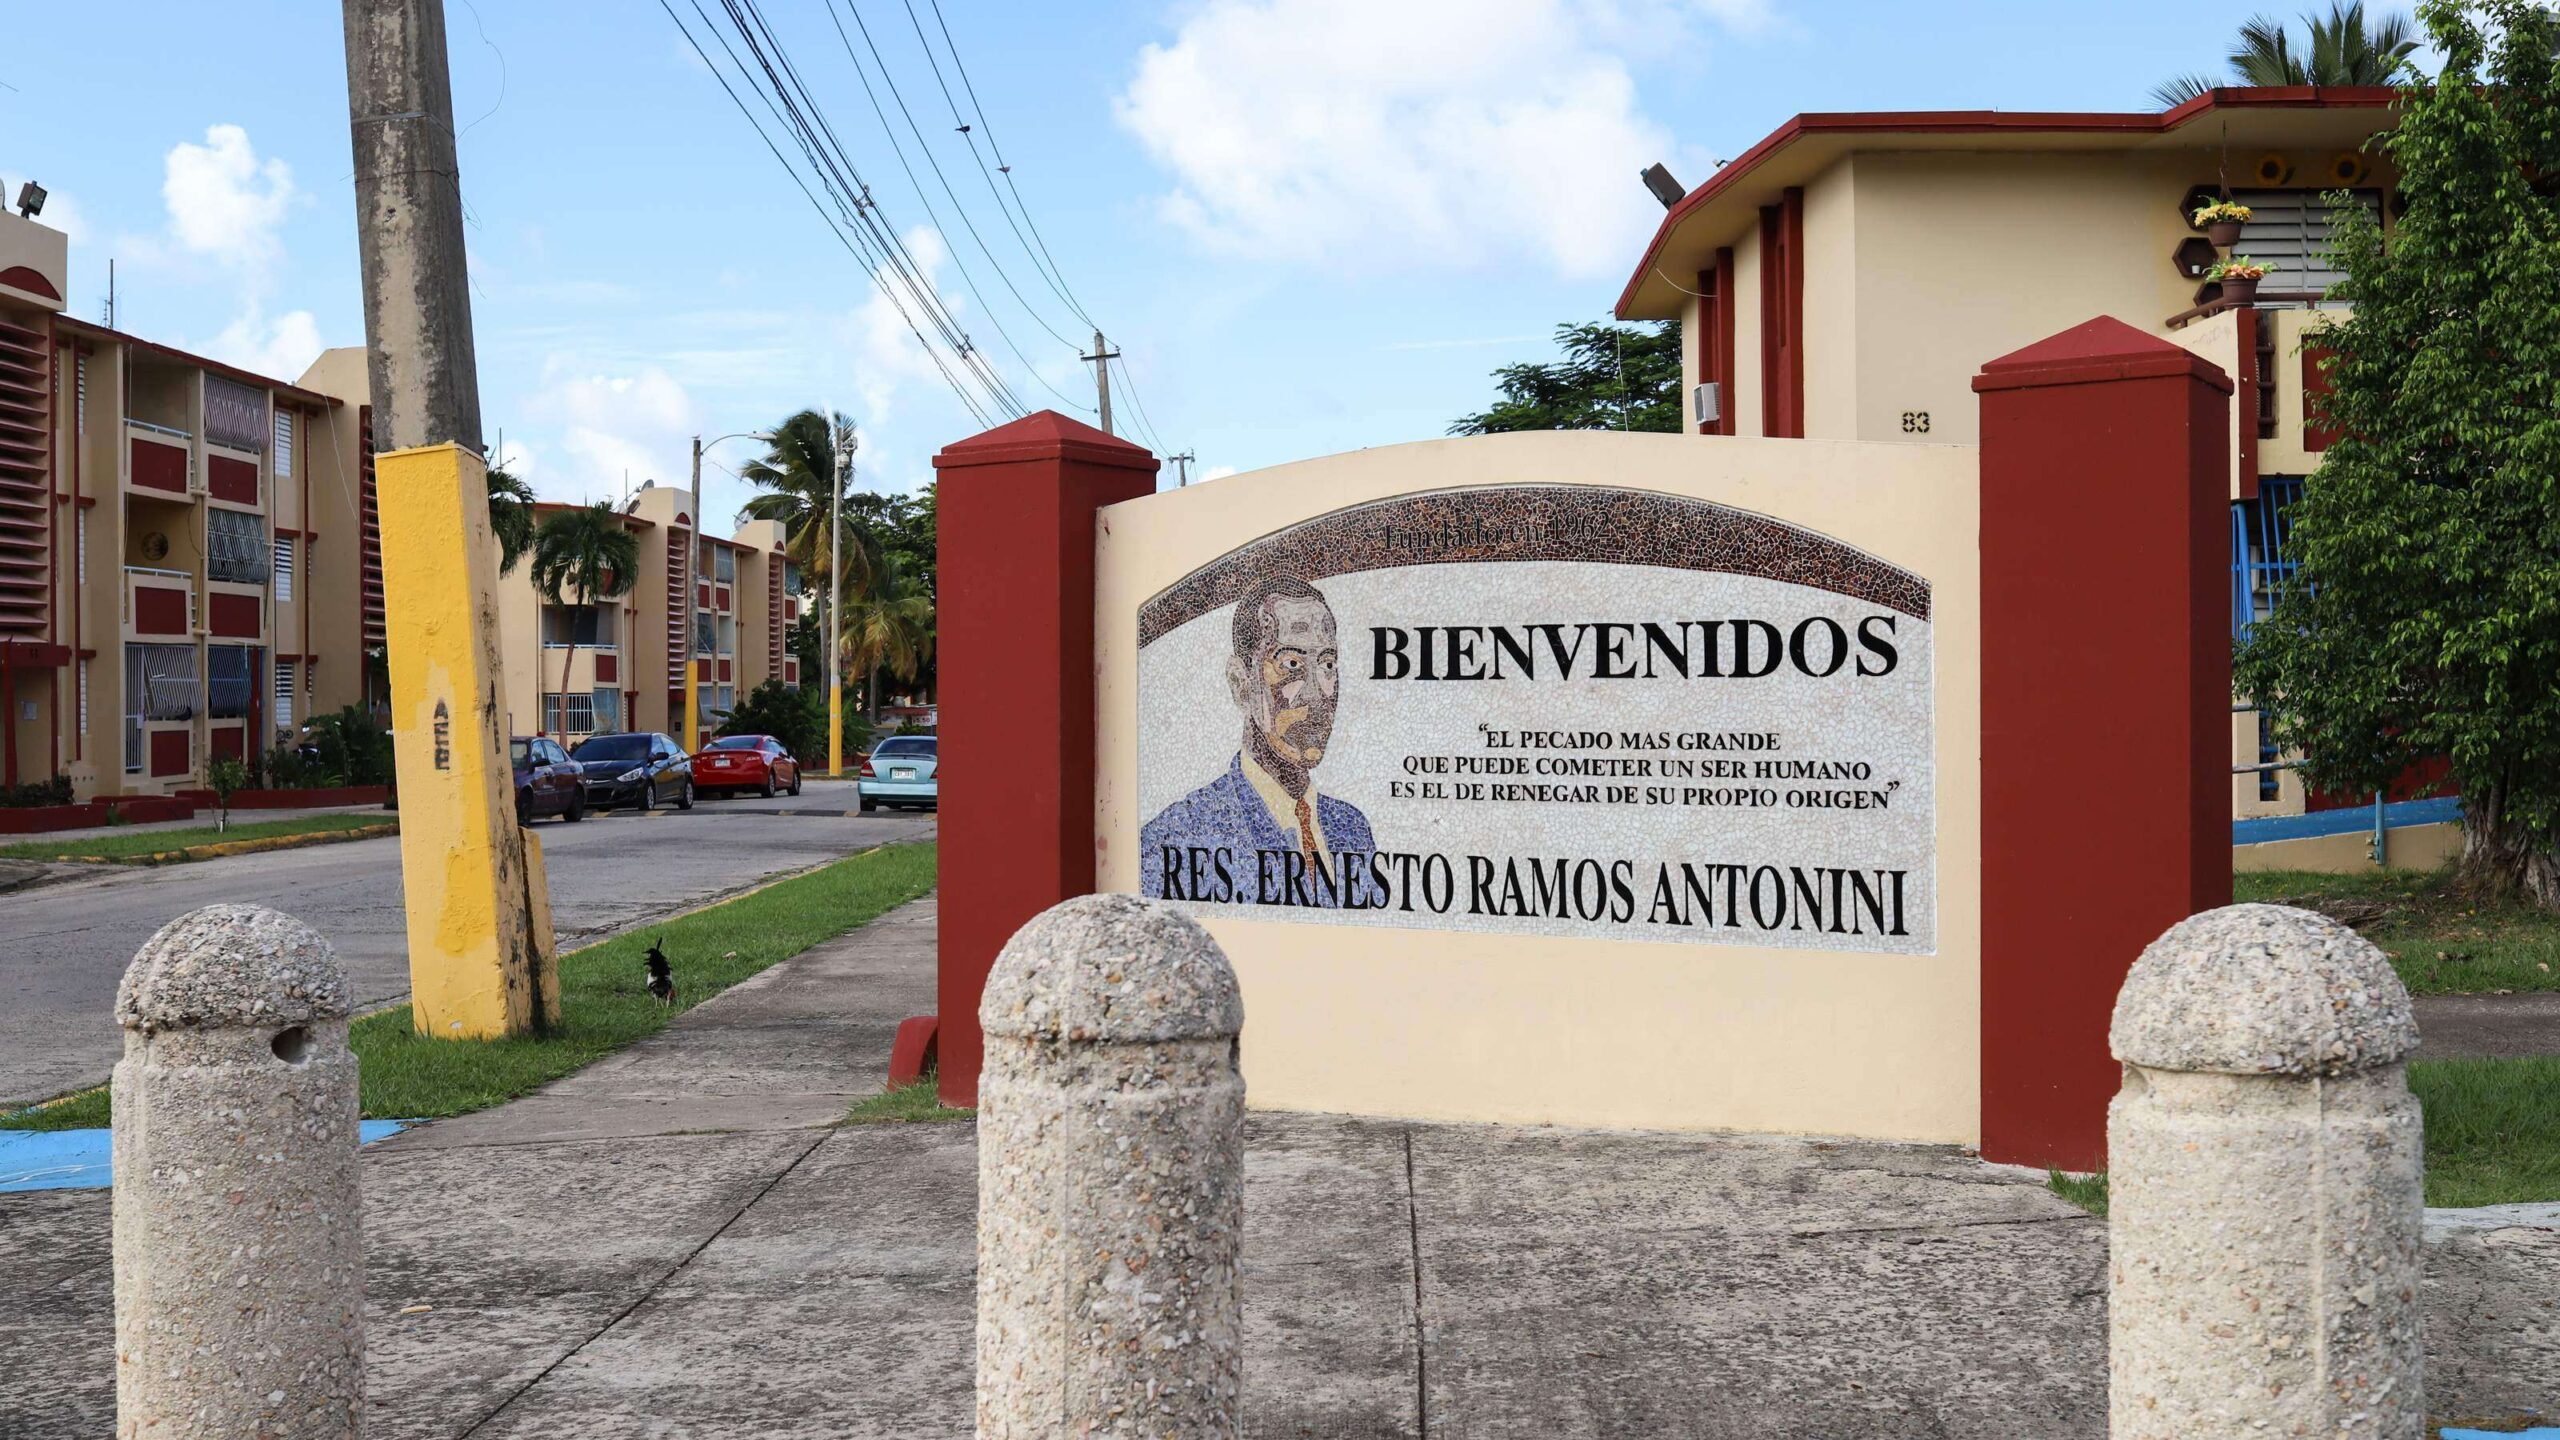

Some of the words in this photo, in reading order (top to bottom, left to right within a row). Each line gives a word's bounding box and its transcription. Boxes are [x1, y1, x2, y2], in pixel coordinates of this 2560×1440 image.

[1902, 411, 1930, 433] 83
[1384, 518, 1500, 550] Fundado
[1510, 525, 1540, 543] en
[1551, 511, 1611, 542] 1962
[1368, 615, 1899, 682] BIENVENIDOS
[1520, 731, 1613, 750] PECADO
[1620, 732, 1671, 750] MAS
[1677, 732, 1781, 751] GRANDE
[1403, 755, 1449, 776] QUE
[1455, 757, 1530, 775] PUEDE
[1536, 757, 1652, 777] COMETER
[1660, 759, 1695, 778] UN
[1701, 760, 1747, 779] SER
[1754, 760, 1871, 781] HUMANO
[1390, 781, 1415, 799] ES
[1422, 782, 1449, 800] EL
[1455, 783, 1484, 801] DE
[1491, 784, 1600, 803] RENEGAR
[1606, 785, 1639, 804] DE
[1646, 787, 1675, 806] SU
[1683, 788, 1777, 807] PROPIO
[1160, 846, 1244, 905] RES.
[1256, 848, 1455, 914] ERNESTO
[1467, 855, 1635, 924] RAMOS
[1647, 861, 1910, 936] ANTONINI
